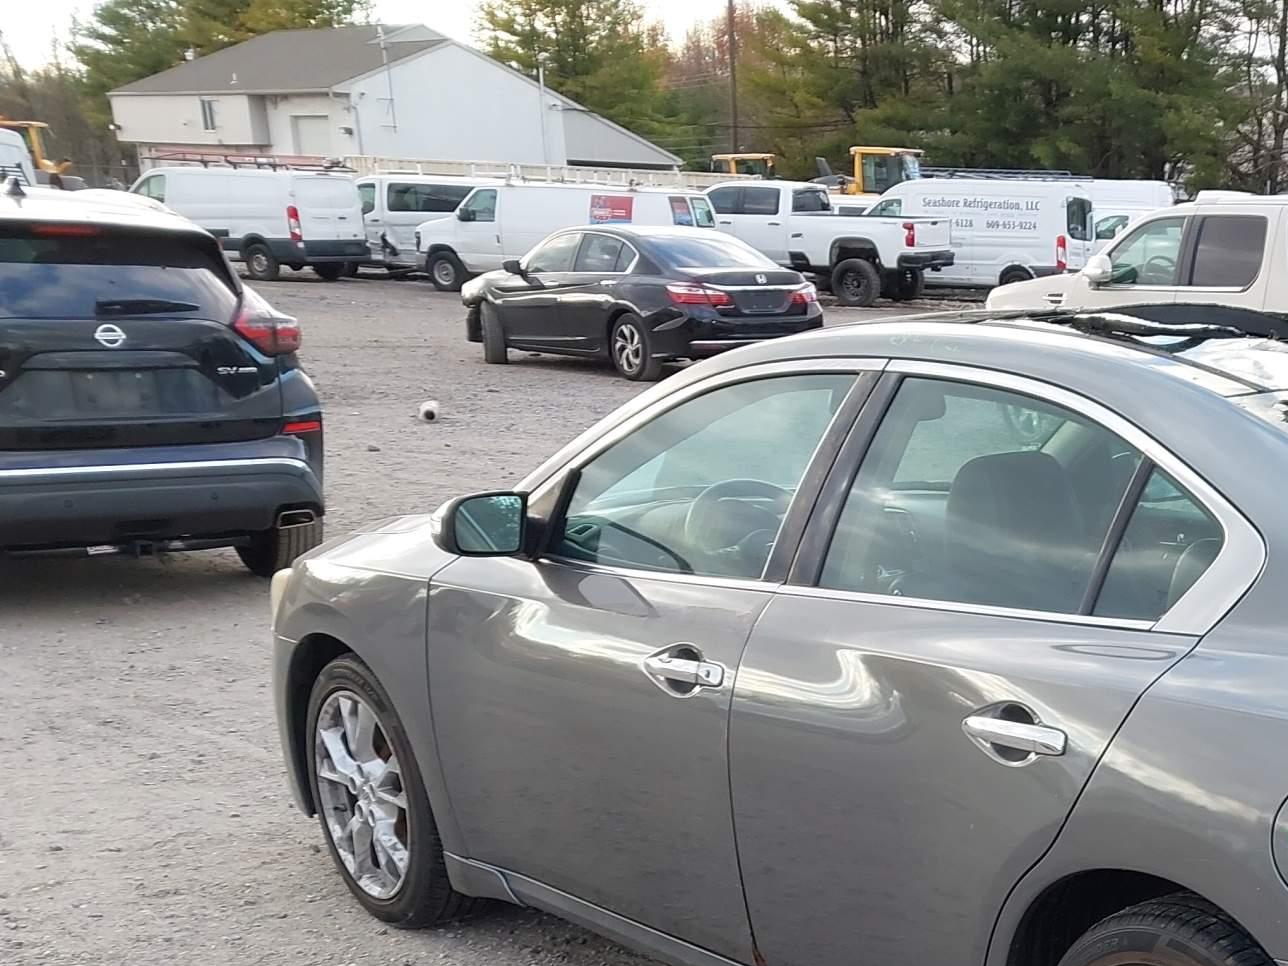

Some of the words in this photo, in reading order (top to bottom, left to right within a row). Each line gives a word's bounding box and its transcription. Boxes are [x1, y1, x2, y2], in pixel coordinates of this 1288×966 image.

[922, 197, 961, 208] Seashore
[963, 198, 1023, 212] Refrigeration,
[1025, 201, 1040, 211] LLC
